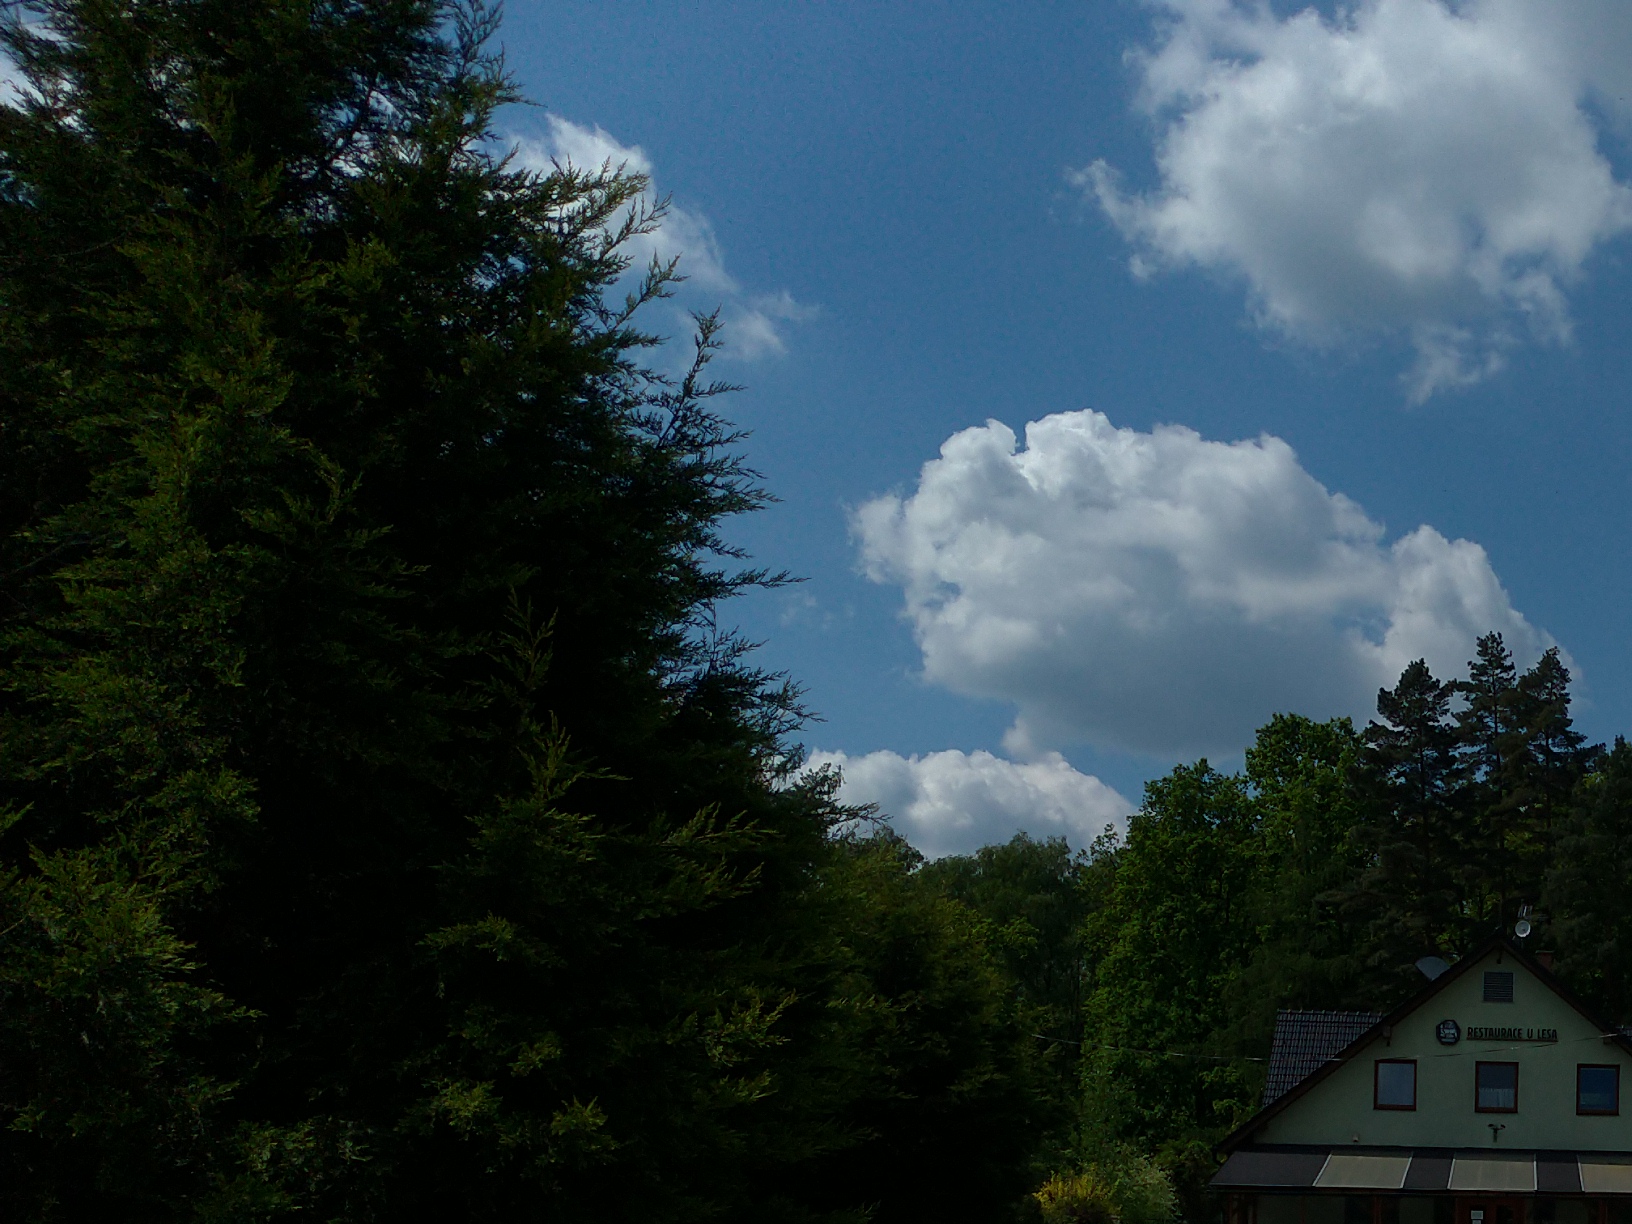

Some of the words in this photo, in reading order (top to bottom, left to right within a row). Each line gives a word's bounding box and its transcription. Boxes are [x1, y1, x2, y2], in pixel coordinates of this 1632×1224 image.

[1467, 1027, 1522, 1039] RESTAURACE
[1527, 1028, 1533, 1039] U
[1537, 1029, 1557, 1039] LESA
